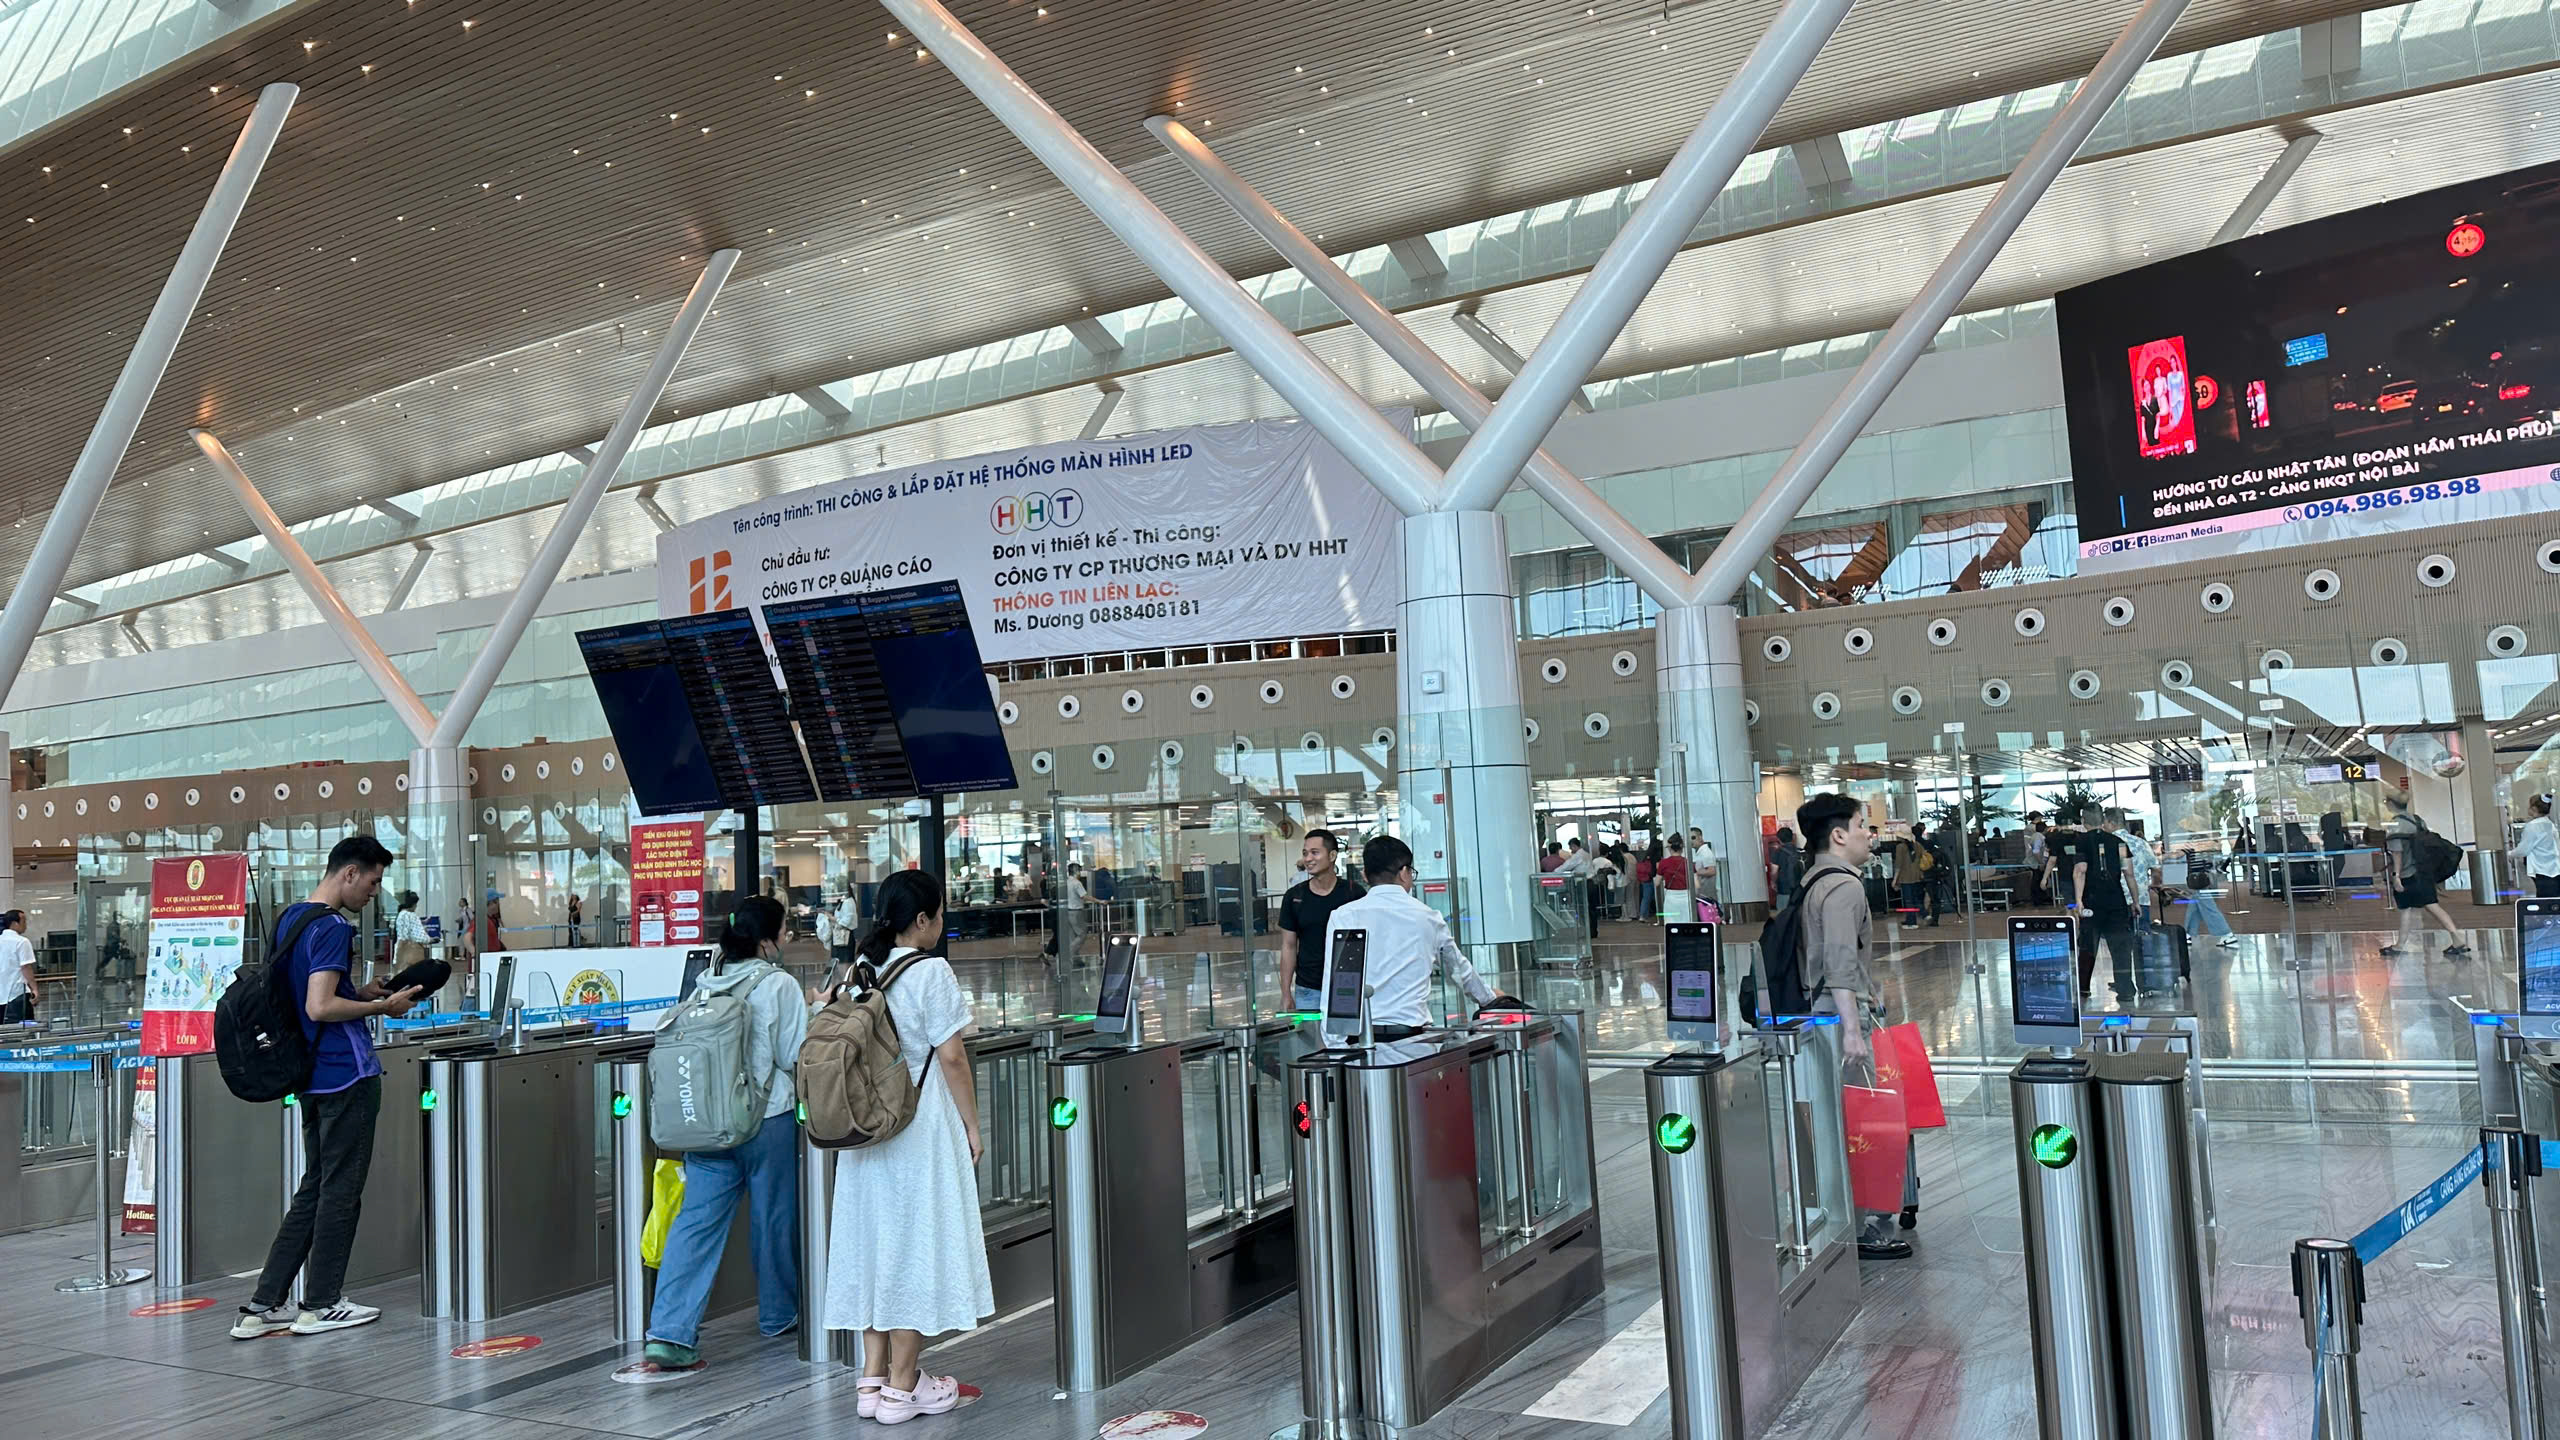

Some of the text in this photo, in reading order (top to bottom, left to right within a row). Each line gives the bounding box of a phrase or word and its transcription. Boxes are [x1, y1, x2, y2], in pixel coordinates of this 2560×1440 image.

[2153, 483, 2206, 501] HƯỚNG
[2208, 475, 2229, 491] TỪ
[2267, 462, 2310, 480] NHẬT
[2313, 456, 2347, 472] TÂN
[2353, 446, 2410, 468] (ĐOẠN
[2459, 428, 2502, 448] THÁI
[733, 444, 1193, 534] Tên công trình: THI CÔNG & LẮP ĐẶT HỆ THỐNG MÀN HÌNH LED
[2153, 502, 2182, 518] ĐẾN
[2185, 497, 2215, 513] NHÀ
[2217, 495, 2238, 506] GA
[2240, 490, 2258, 503] T2
[2269, 480, 2310, 498] CẢNG
[2314, 471, 2356, 490] HKQT
[2359, 466, 2389, 482] NỘI
[2392, 461, 2420, 477] BÀI
[2304, 478, 2481, 520] 094.986.98.98
[993, 545, 1026, 560] Đơn
[1031, 540, 1045, 559] vị
[1051, 531, 1089, 554] thiết
[1096, 528, 1119, 548] kế
[1133, 529, 1159, 545] Thi
[1166, 525, 1221, 543] công:
[2150, 525, 2223, 545] Bizman Media
[761, 547, 831, 572] Chủ đầu tư:
[995, 539, 1348, 587] CÔNG TY CP THƯƠNG MẠI VÀ DV HHT
[762, 575, 798, 601] CÔNG
[801, 576, 815, 593] TY
[819, 573, 837, 590] CP
[841, 562, 893, 587] QUẢNG
[897, 555, 932, 576] CÁO
[941, 584, 957, 593] 10:29
[993, 582, 1180, 613] THÔNG TIN LIÊN LẠC:
[995, 600, 1200, 634] Ms. Dương 0888408181
[2345, 767, 2362, 778] 12
[10, 1048, 39, 1058] TIA
[117, 1057, 147, 1069] ACV
[679, 1081, 697, 1123] YONEX
